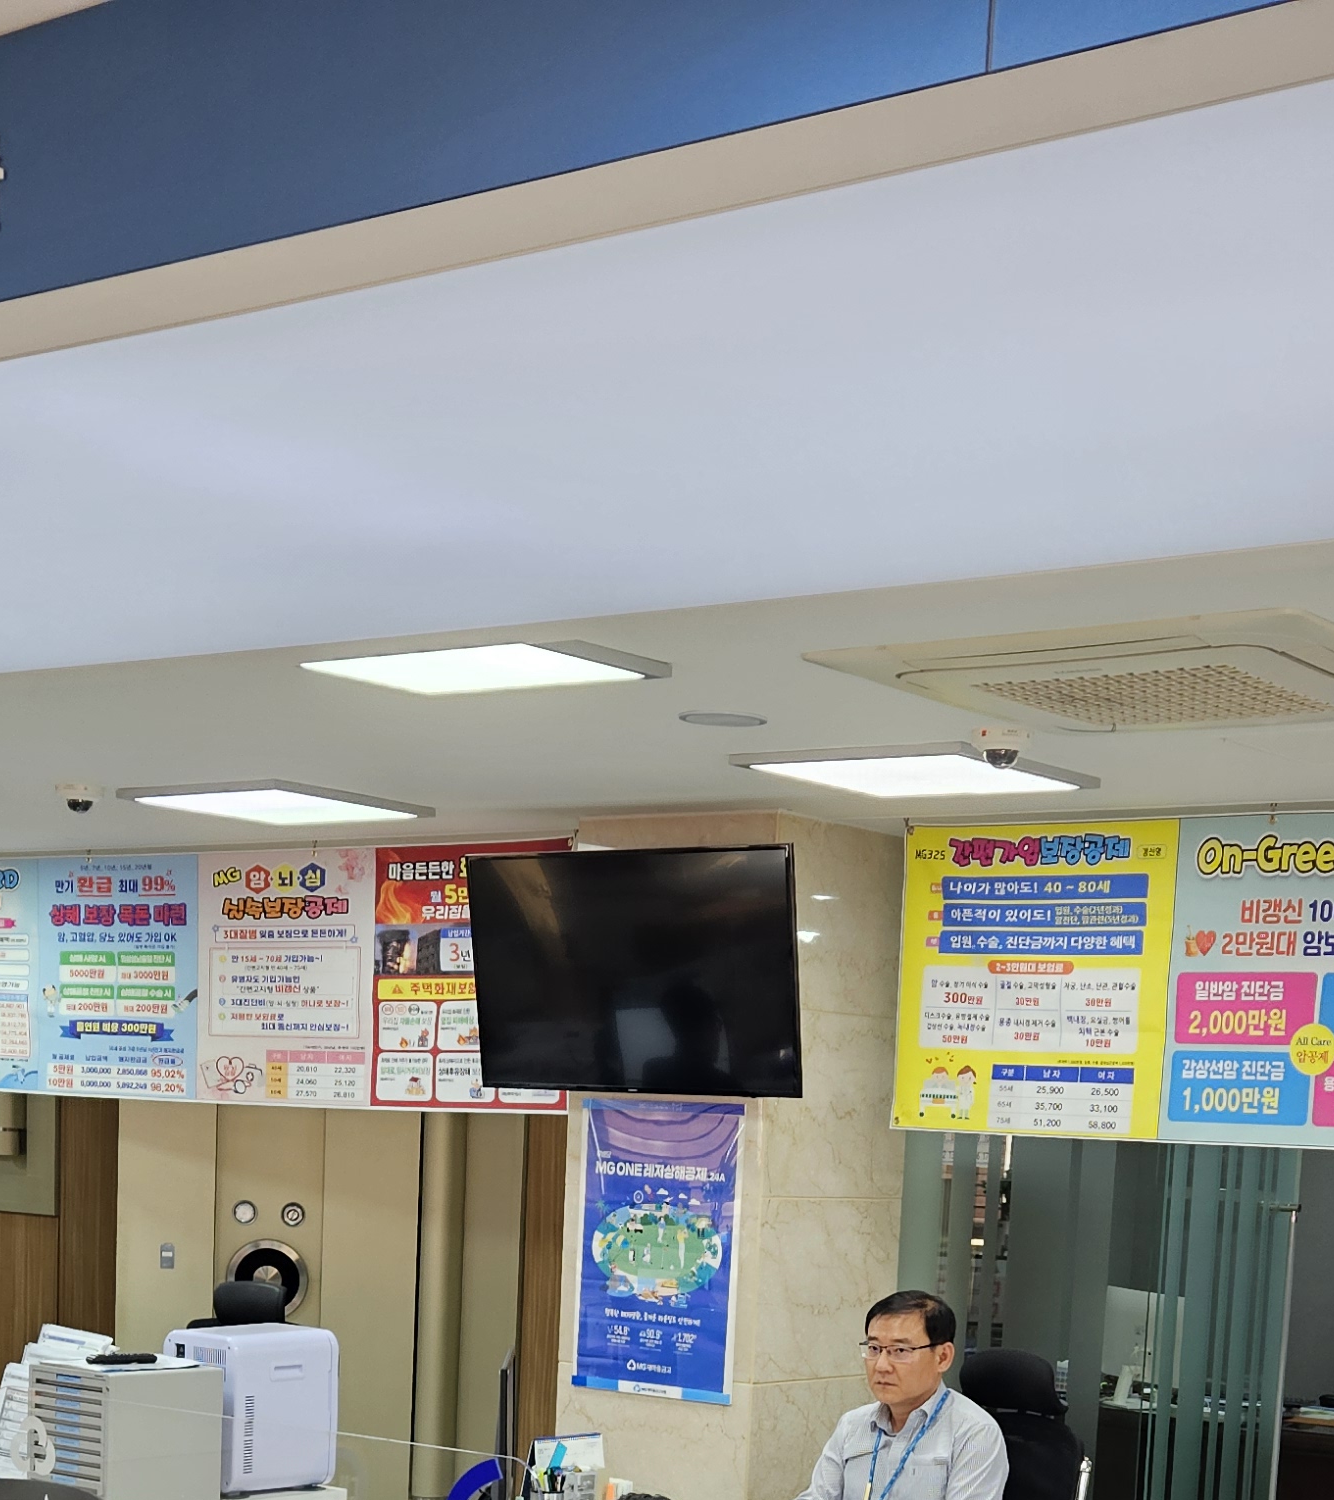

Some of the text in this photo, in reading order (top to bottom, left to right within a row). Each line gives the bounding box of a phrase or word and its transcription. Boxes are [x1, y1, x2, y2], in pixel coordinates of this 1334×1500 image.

[915, 833, 1131, 867] MG325 간편가입보장공제
[213, 867, 320, 888] MG 암 뇌 심
[388, 861, 455, 881] 마음든든한
[55, 875, 176, 894] 만기 환급 최대 99%
[950, 880, 1111, 895] 나이가 많아도! 40 80세
[84, 904, 116, 926] 보장
[1240, 898, 1304, 924] 비갱신
[1221, 930, 1297, 958] 2만원대
[944, 992, 983, 1005] 300만원
[1195, 981, 1284, 1001] 일반암 진단금
[1188, 1008, 1287, 1037] 2,000만원
[1295, 1037, 1332, 1047] All Care
[1296, 1050, 1329, 1064] 암공제
[1182, 1060, 1285, 1081] 갑상선암 진단금
[1036, 1086, 1065, 1095] 25,900
[1091, 1087, 1119, 1097] 26,500
[1035, 1102, 1063, 1112] 35,700
[1089, 1104, 1118, 1114] 33,100
[1182, 1087, 1280, 1115] 1,000만원
[1033, 1118, 1061, 1128] 51,200
[1088, 1120, 1116, 1130] 58,800
[595, 1161, 616, 1175] MG
[617, 1164, 643, 1176] ONE
